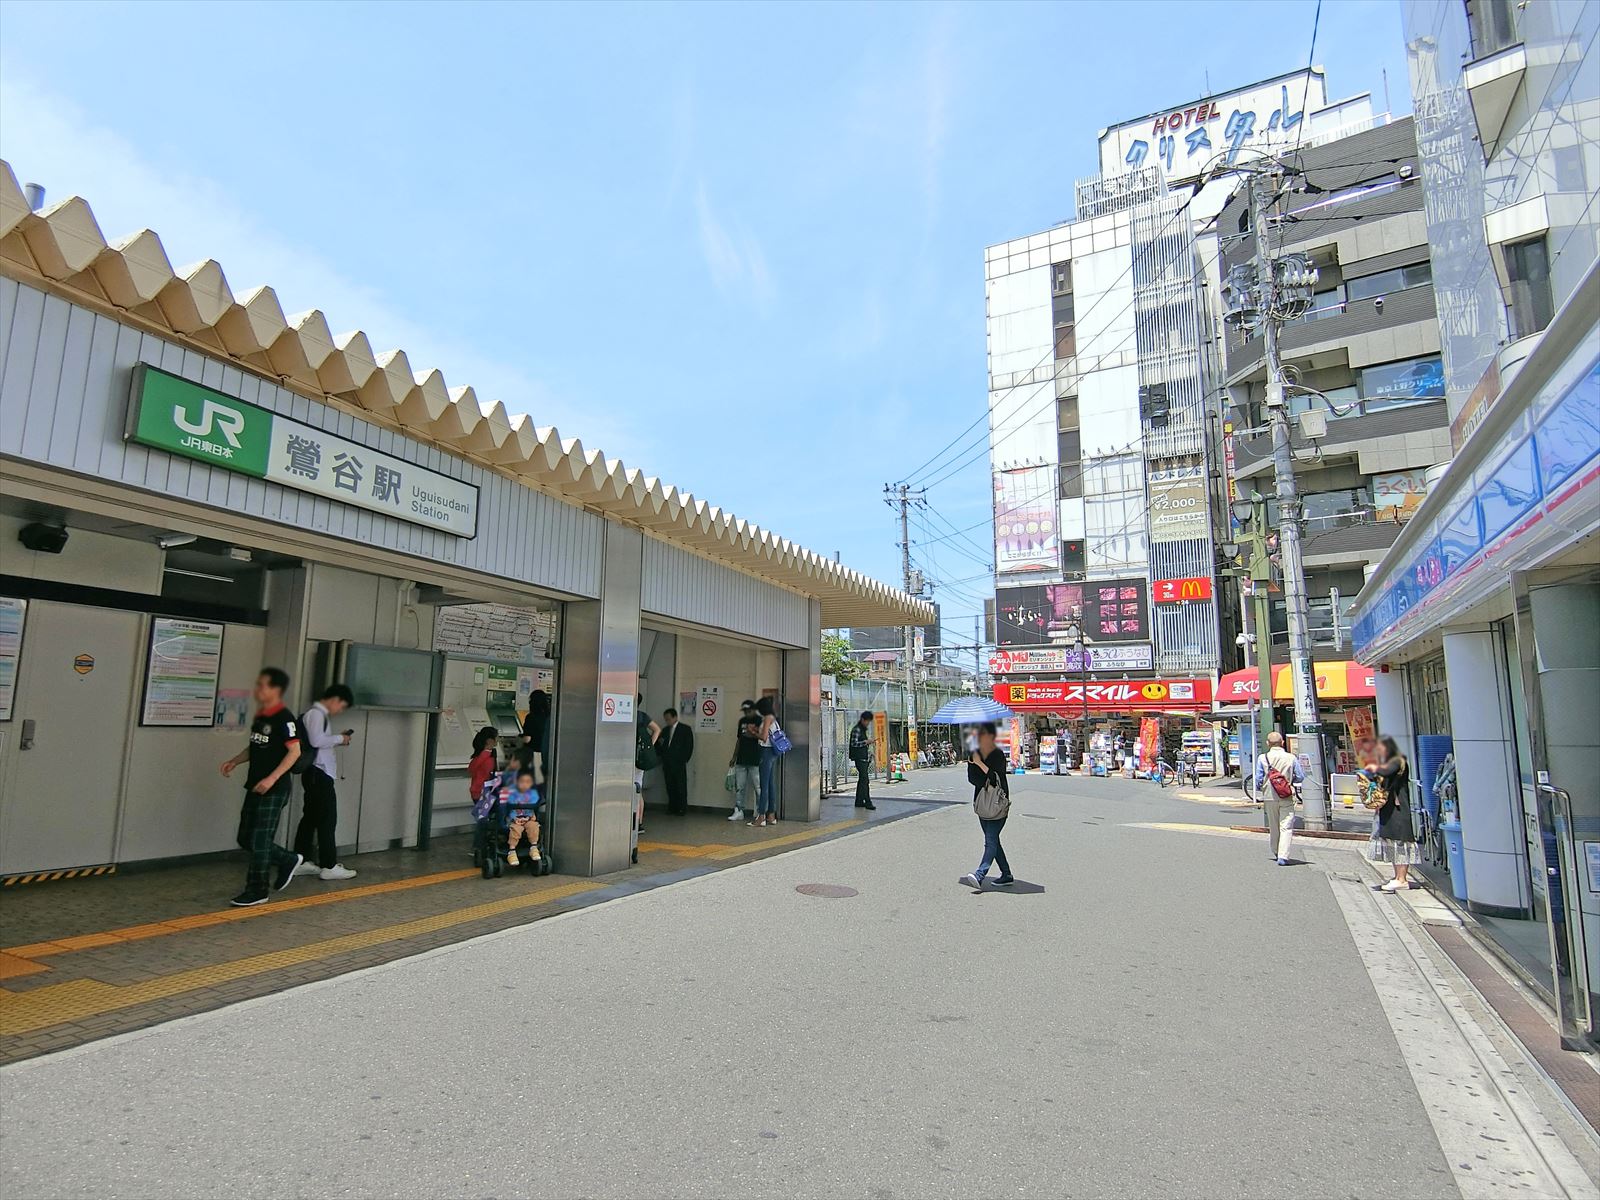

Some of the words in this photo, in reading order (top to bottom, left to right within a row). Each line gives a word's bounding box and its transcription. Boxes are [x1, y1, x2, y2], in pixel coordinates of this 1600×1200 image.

[1126, 85, 1303, 170] クリスタル
[1153, 102, 1220, 135] HOTEL
[174, 400, 245, 449] JR
[181, 436, 234, 459] JR東日本
[286, 434, 402, 505] 鶯谷駅
[411, 502, 449, 522] Station
[412, 485, 470, 514] Uguisudani
[1012, 687, 1024, 699] 薬
[1064, 685, 1138, 701] スマイル
[1232, 680, 1259, 694] 宝くじ
